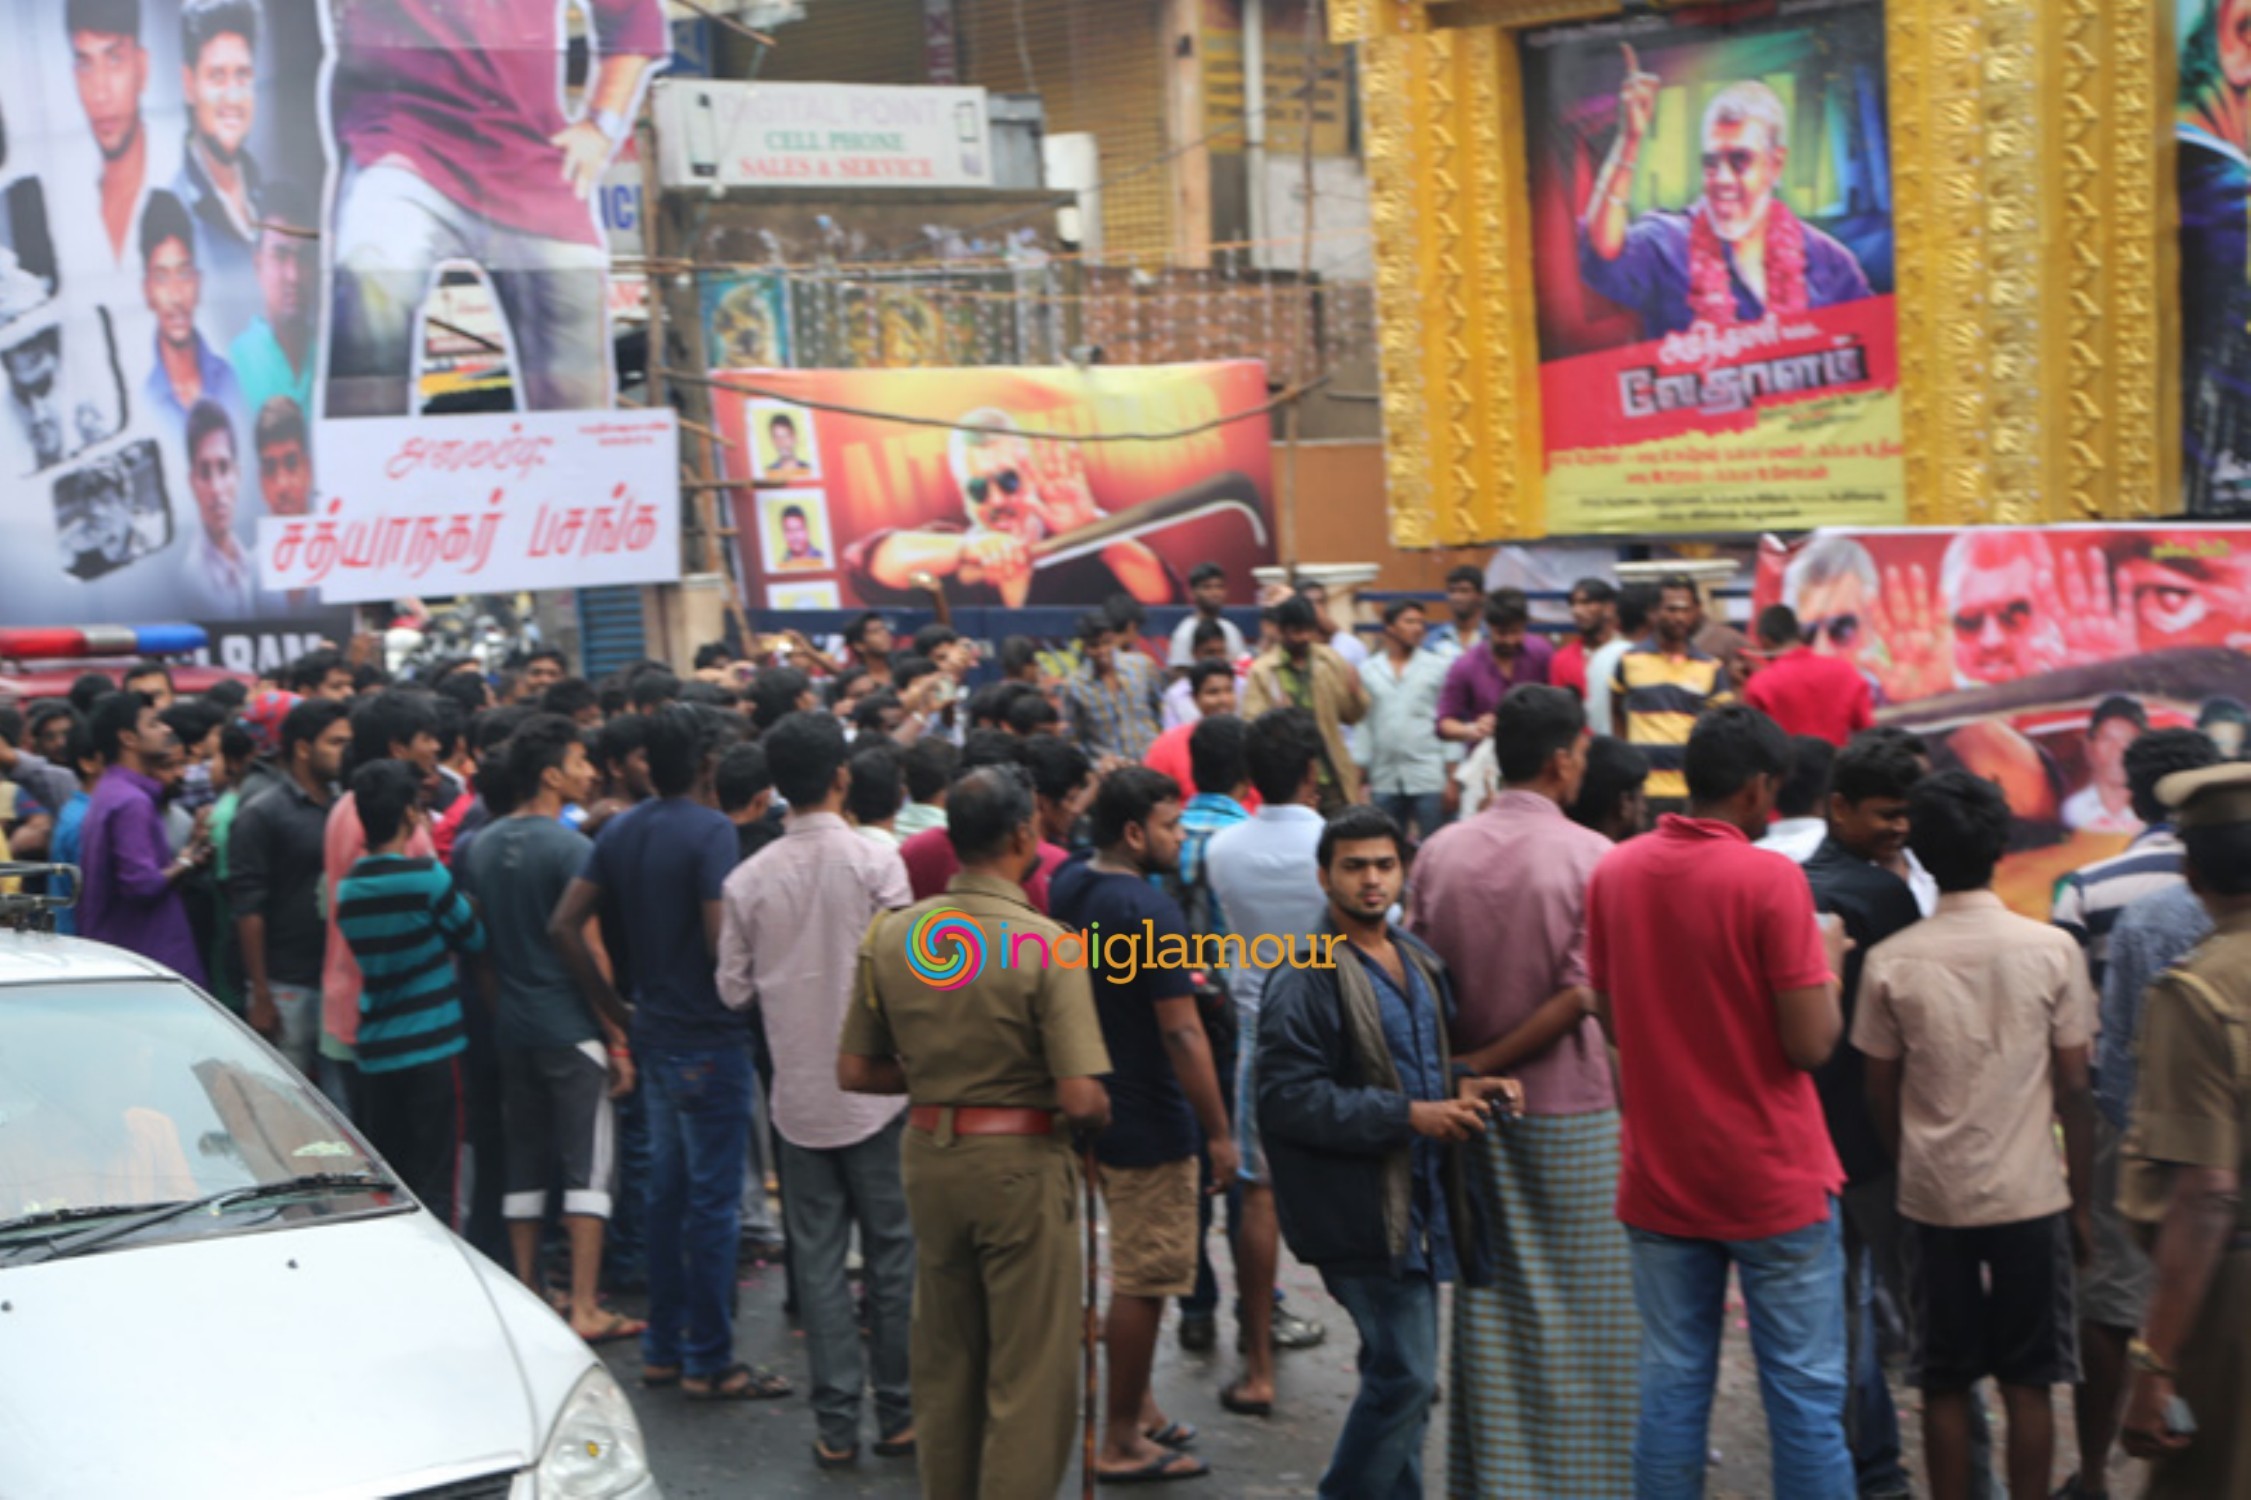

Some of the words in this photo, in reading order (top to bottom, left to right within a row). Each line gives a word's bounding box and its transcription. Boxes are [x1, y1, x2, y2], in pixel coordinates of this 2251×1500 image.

[849, 95, 940, 125] POINT
[763, 129, 820, 151] CELL
[828, 130, 906, 151] PHONE
[738, 157, 811, 177] SALES
[837, 157, 935, 178] SERVICE
[526, 482, 659, 559] பசங்க
